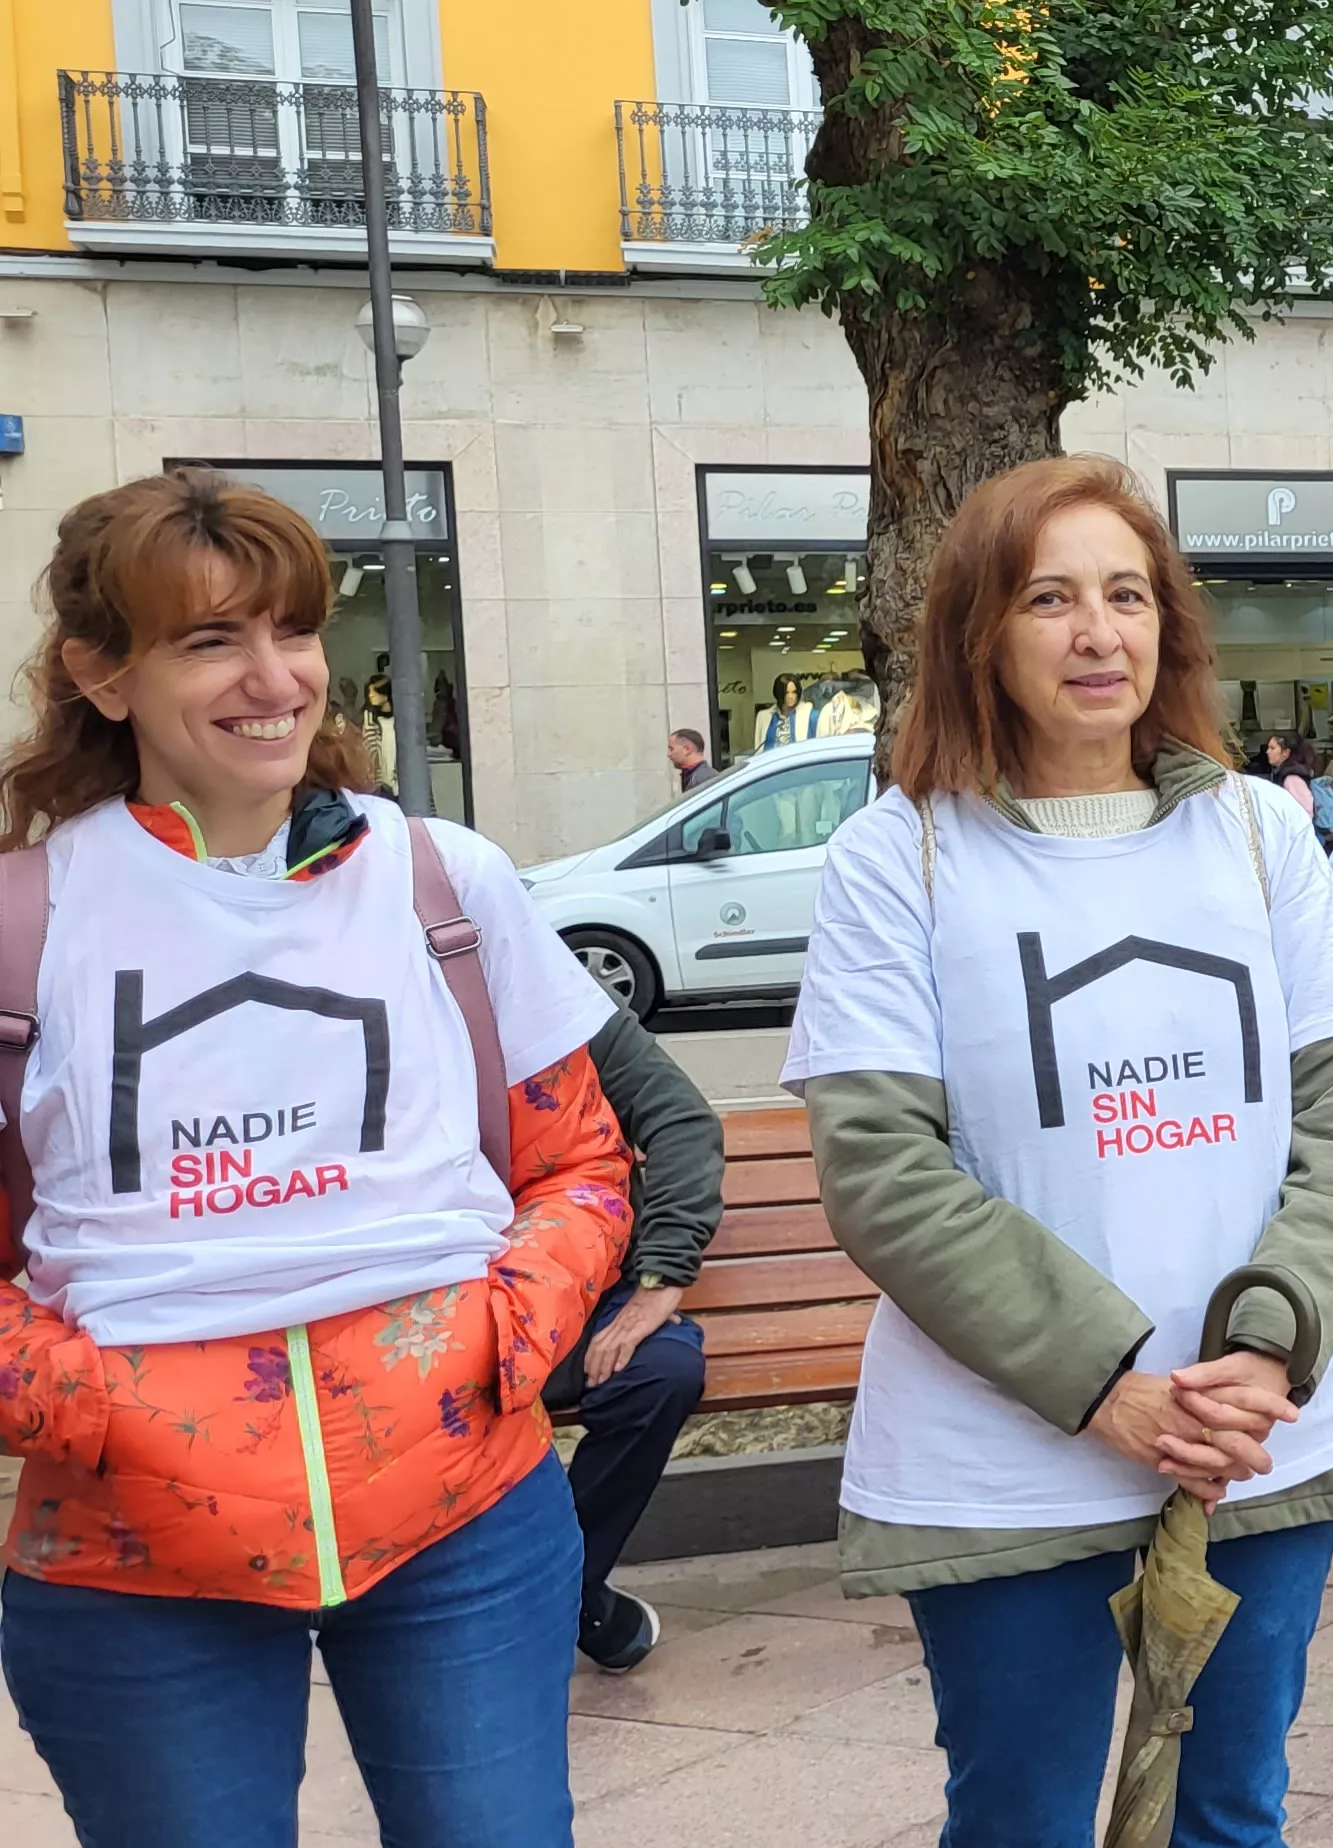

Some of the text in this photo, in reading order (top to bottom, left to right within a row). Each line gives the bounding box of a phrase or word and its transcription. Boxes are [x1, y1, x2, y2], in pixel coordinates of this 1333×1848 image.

[318, 488, 437, 523] Prito
[717, 490, 816, 522] Pilar
[716, 600, 818, 616] rprieto.es
[1088, 1051, 1206, 1089] NADIE
[1092, 1088, 1157, 1123] SIN
[170, 1101, 318, 1150] NADIE
[1096, 1113, 1237, 1158] HOGAR
[169, 1148, 252, 1189] SIN
[169, 1163, 349, 1219] HOGAR
